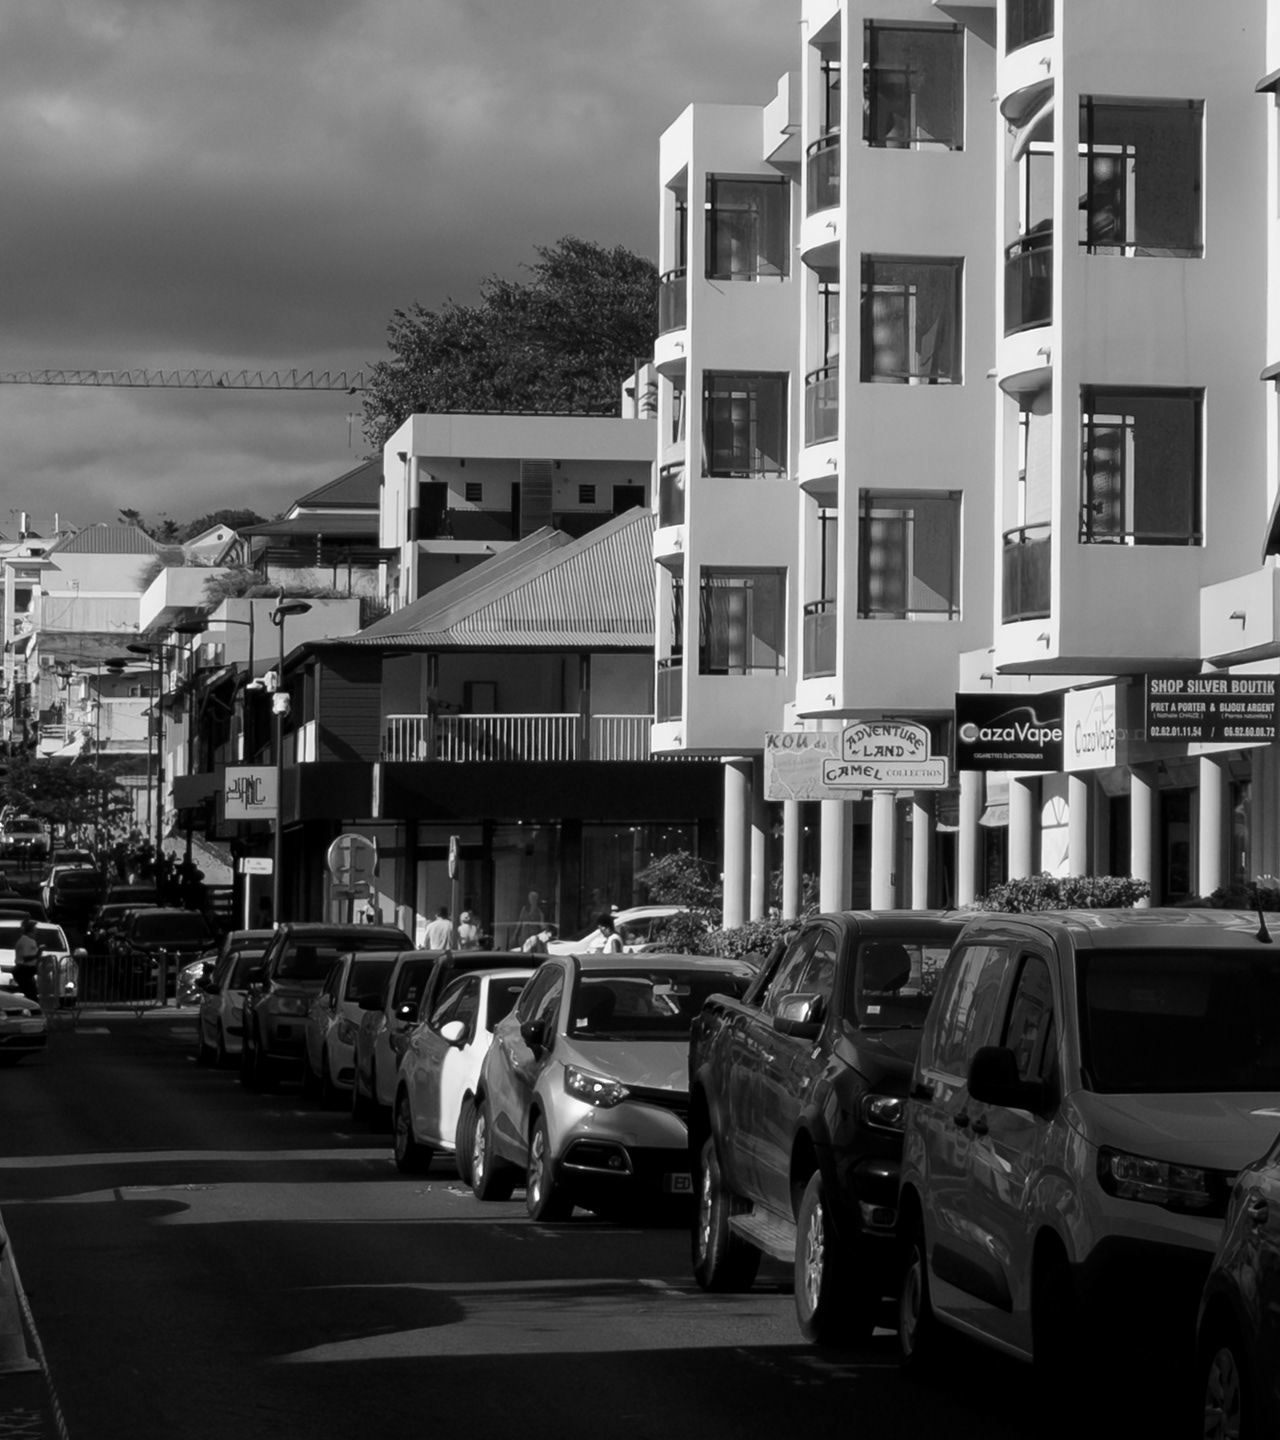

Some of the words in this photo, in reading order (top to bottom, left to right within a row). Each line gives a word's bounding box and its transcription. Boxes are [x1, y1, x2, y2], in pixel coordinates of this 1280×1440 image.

[1150, 679, 1184, 693] SHOP
[1187, 679, 1228, 693] SILVER
[1231, 680, 1275, 694] BOUTIK
[1150, 702, 1169, 712] PRET
[1177, 702, 1206, 712] PORTER
[1219, 703, 1245, 712] BIJOUX
[1246, 703, 1275, 712] ARGENT
[845, 724, 925, 751] ADVENTURE
[959, 722, 1063, 748] CazaVape
[863, 745, 905, 757] LAND
[826, 765, 883, 781] CAMEL
[886, 768, 943, 777] COLLECTION
